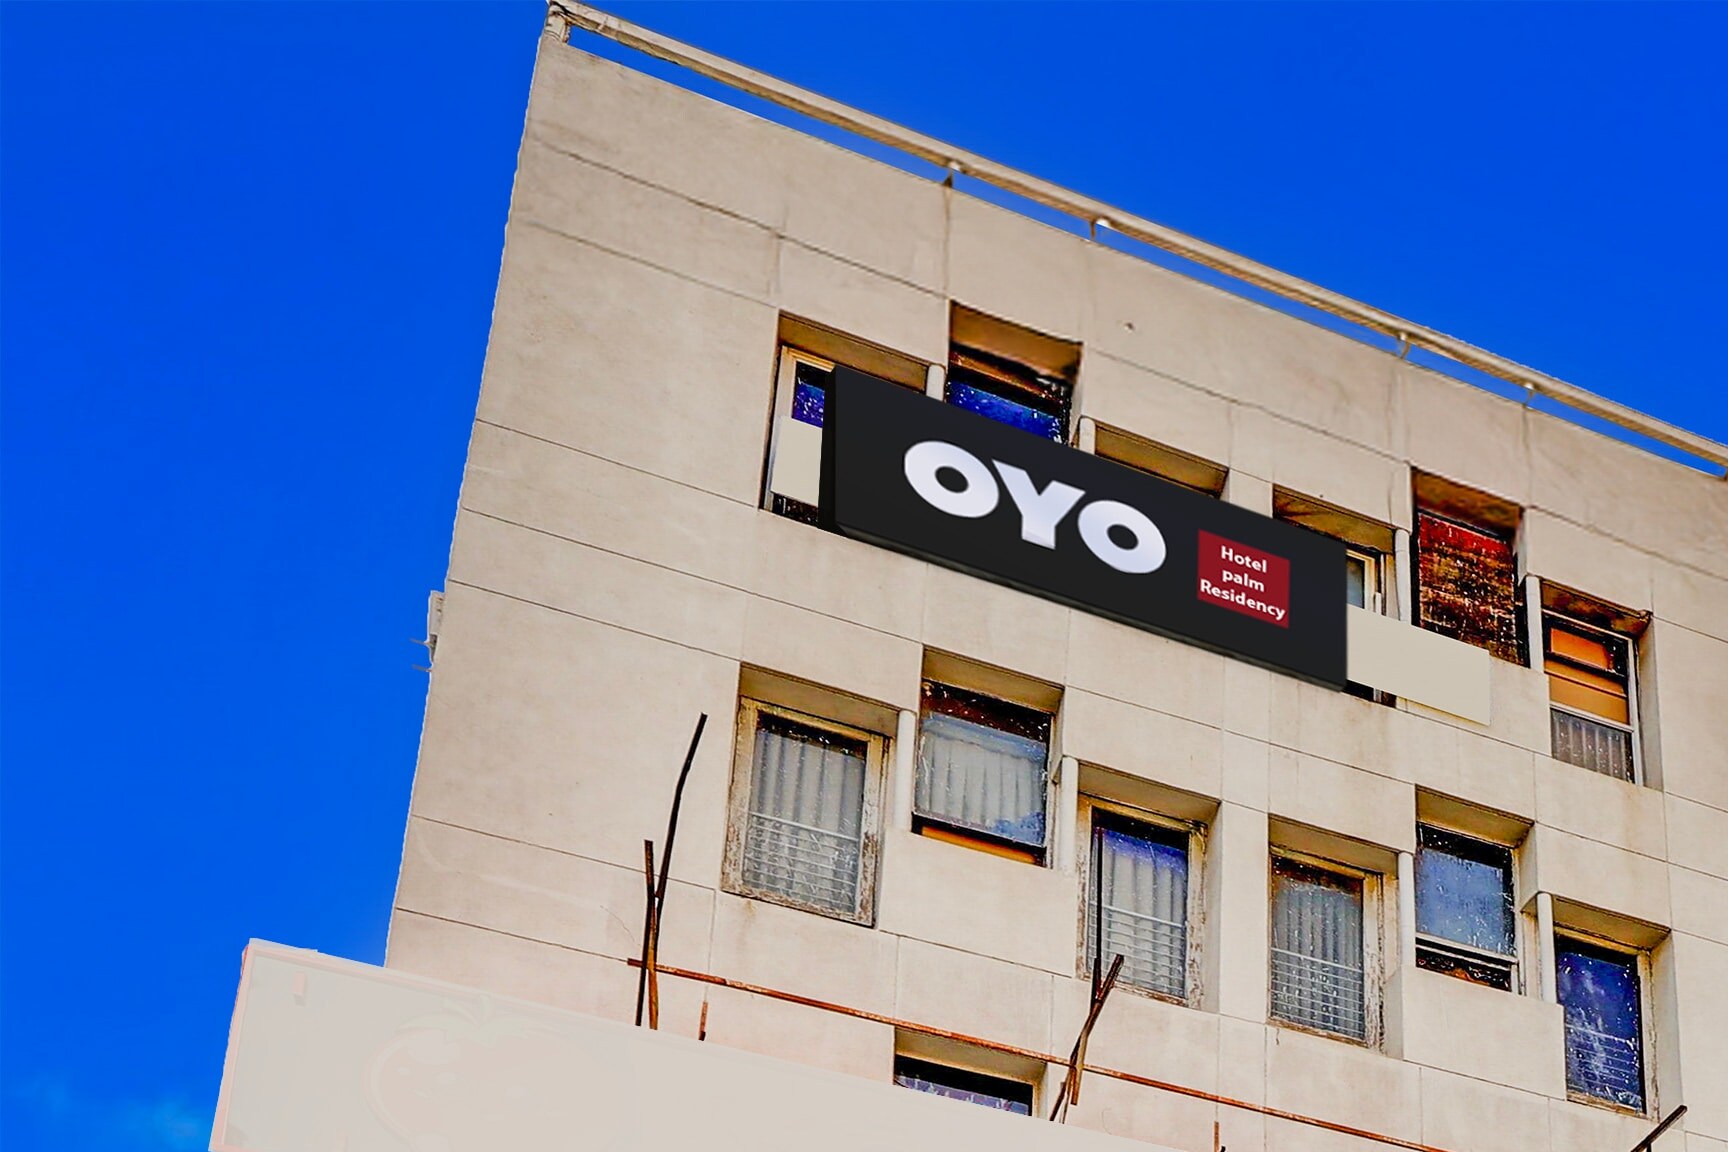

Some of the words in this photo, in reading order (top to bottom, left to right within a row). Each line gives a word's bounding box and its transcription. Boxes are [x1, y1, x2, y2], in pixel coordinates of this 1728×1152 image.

[904, 440, 1166, 574] OYO
[1221, 545, 1267, 573] Hotel
[1222, 570, 1265, 592] palm
[1200, 579, 1286, 620] Residency
